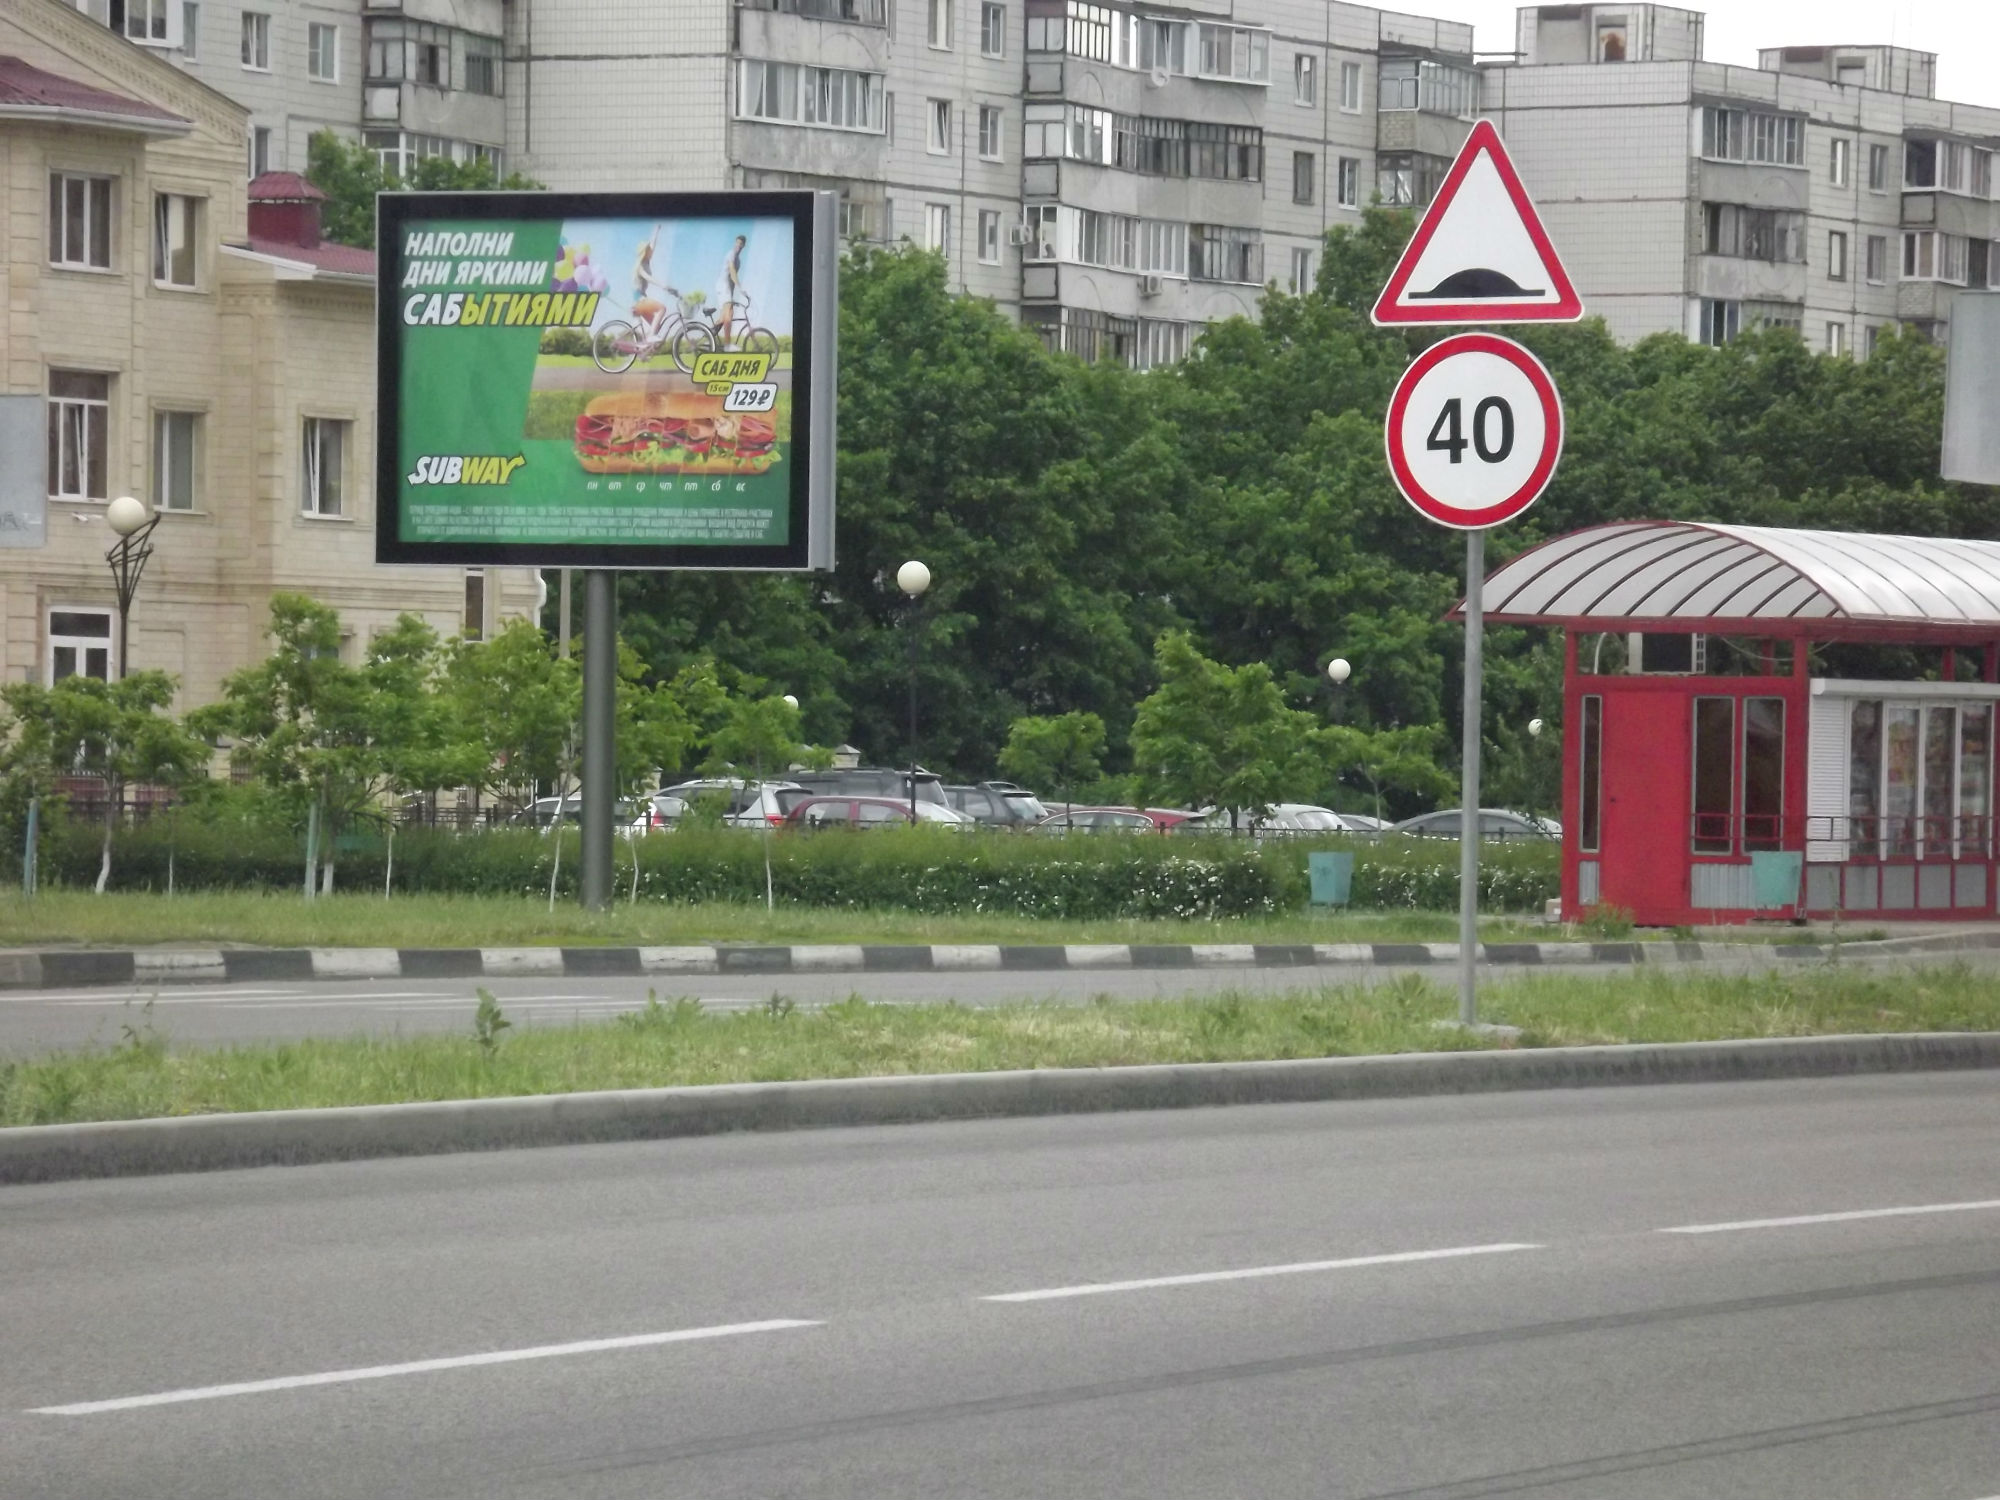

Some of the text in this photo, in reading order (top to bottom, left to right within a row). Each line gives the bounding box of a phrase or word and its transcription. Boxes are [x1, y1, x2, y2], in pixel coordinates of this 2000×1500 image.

[404, 232, 514, 256] НАПОЛНИ
[402, 261, 548, 288] ДНИ ЯРКИМИ
[403, 293, 599, 326] САБЫТИЯМИ
[701, 360, 760, 378] САБ ДНЯ
[1426, 396, 1514, 464] 40
[408, 454, 526, 485] SUBWAY
